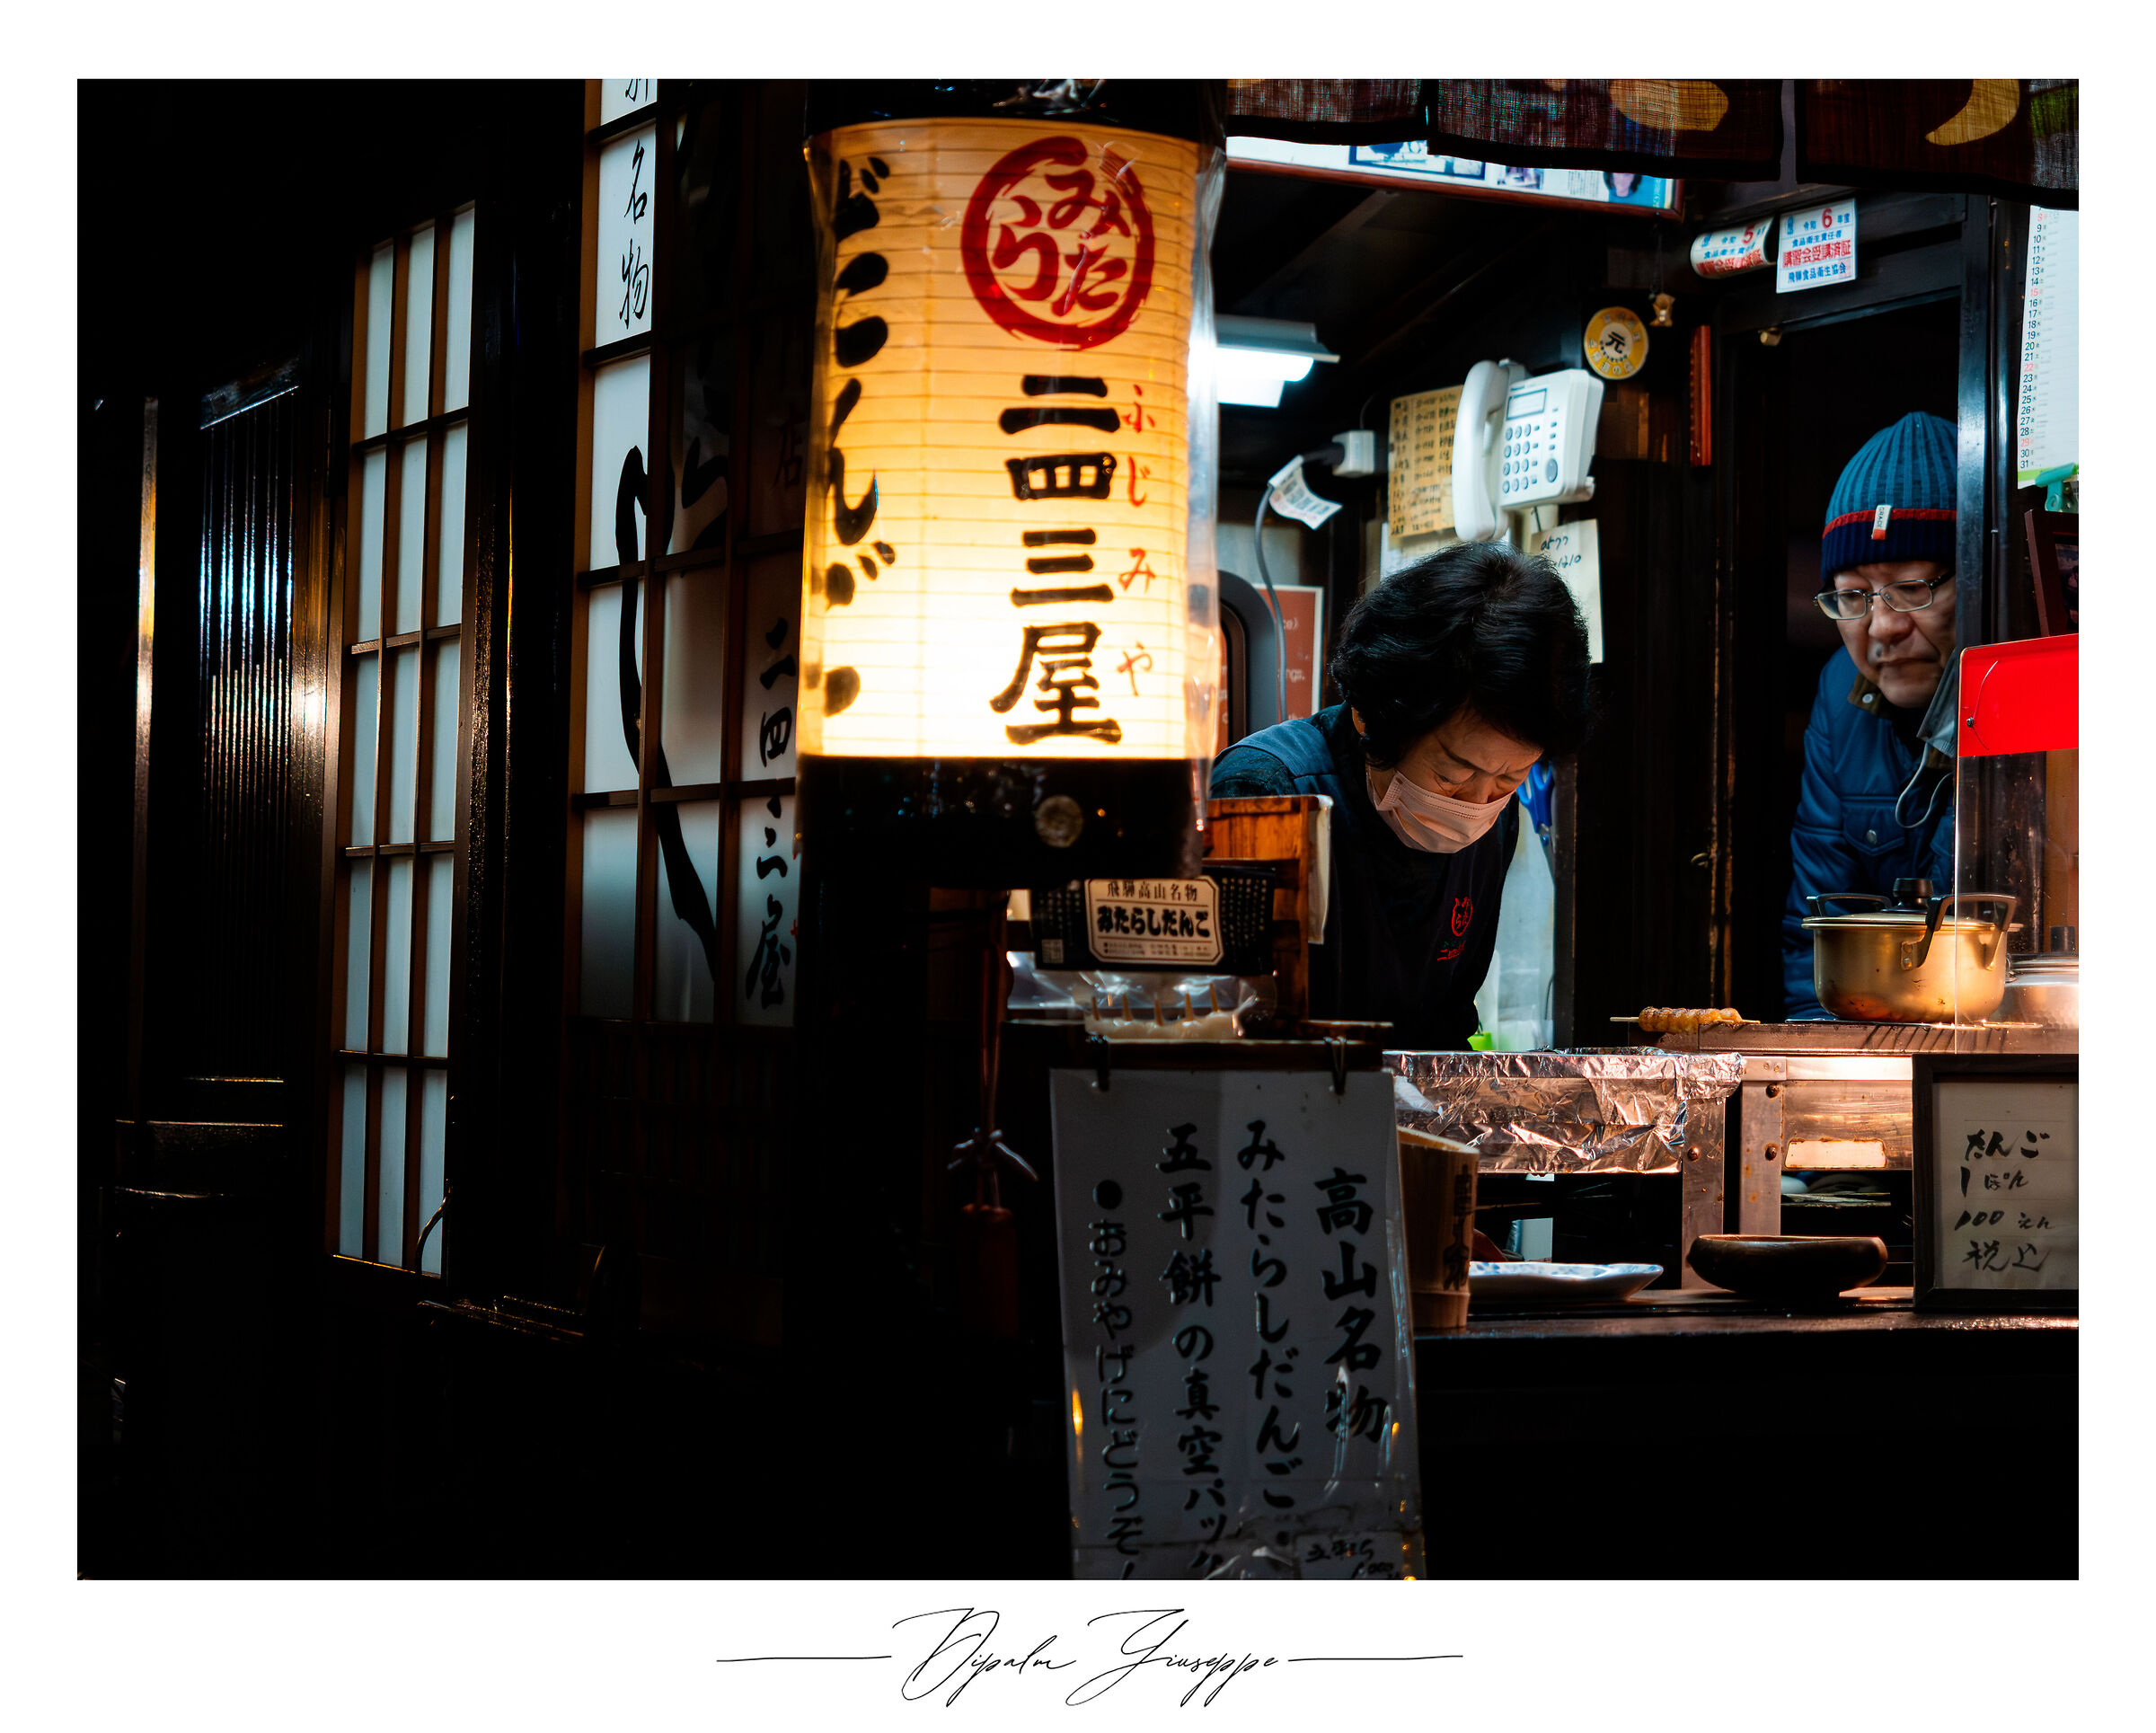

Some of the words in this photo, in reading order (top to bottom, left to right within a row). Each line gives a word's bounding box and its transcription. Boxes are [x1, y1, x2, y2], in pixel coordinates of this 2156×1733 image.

[1822, 208, 1833, 229] 6
[1605, 332, 1626, 354] 元
[1117, 385, 1158, 697] ふじみや
[989, 374, 1122, 747] 二四三屋
[1097, 905, 1211, 938] みたらしだんご
[1961, 1239, 2052, 1273] 税込
[1313, 1167, 1389, 1446] 高山名物
